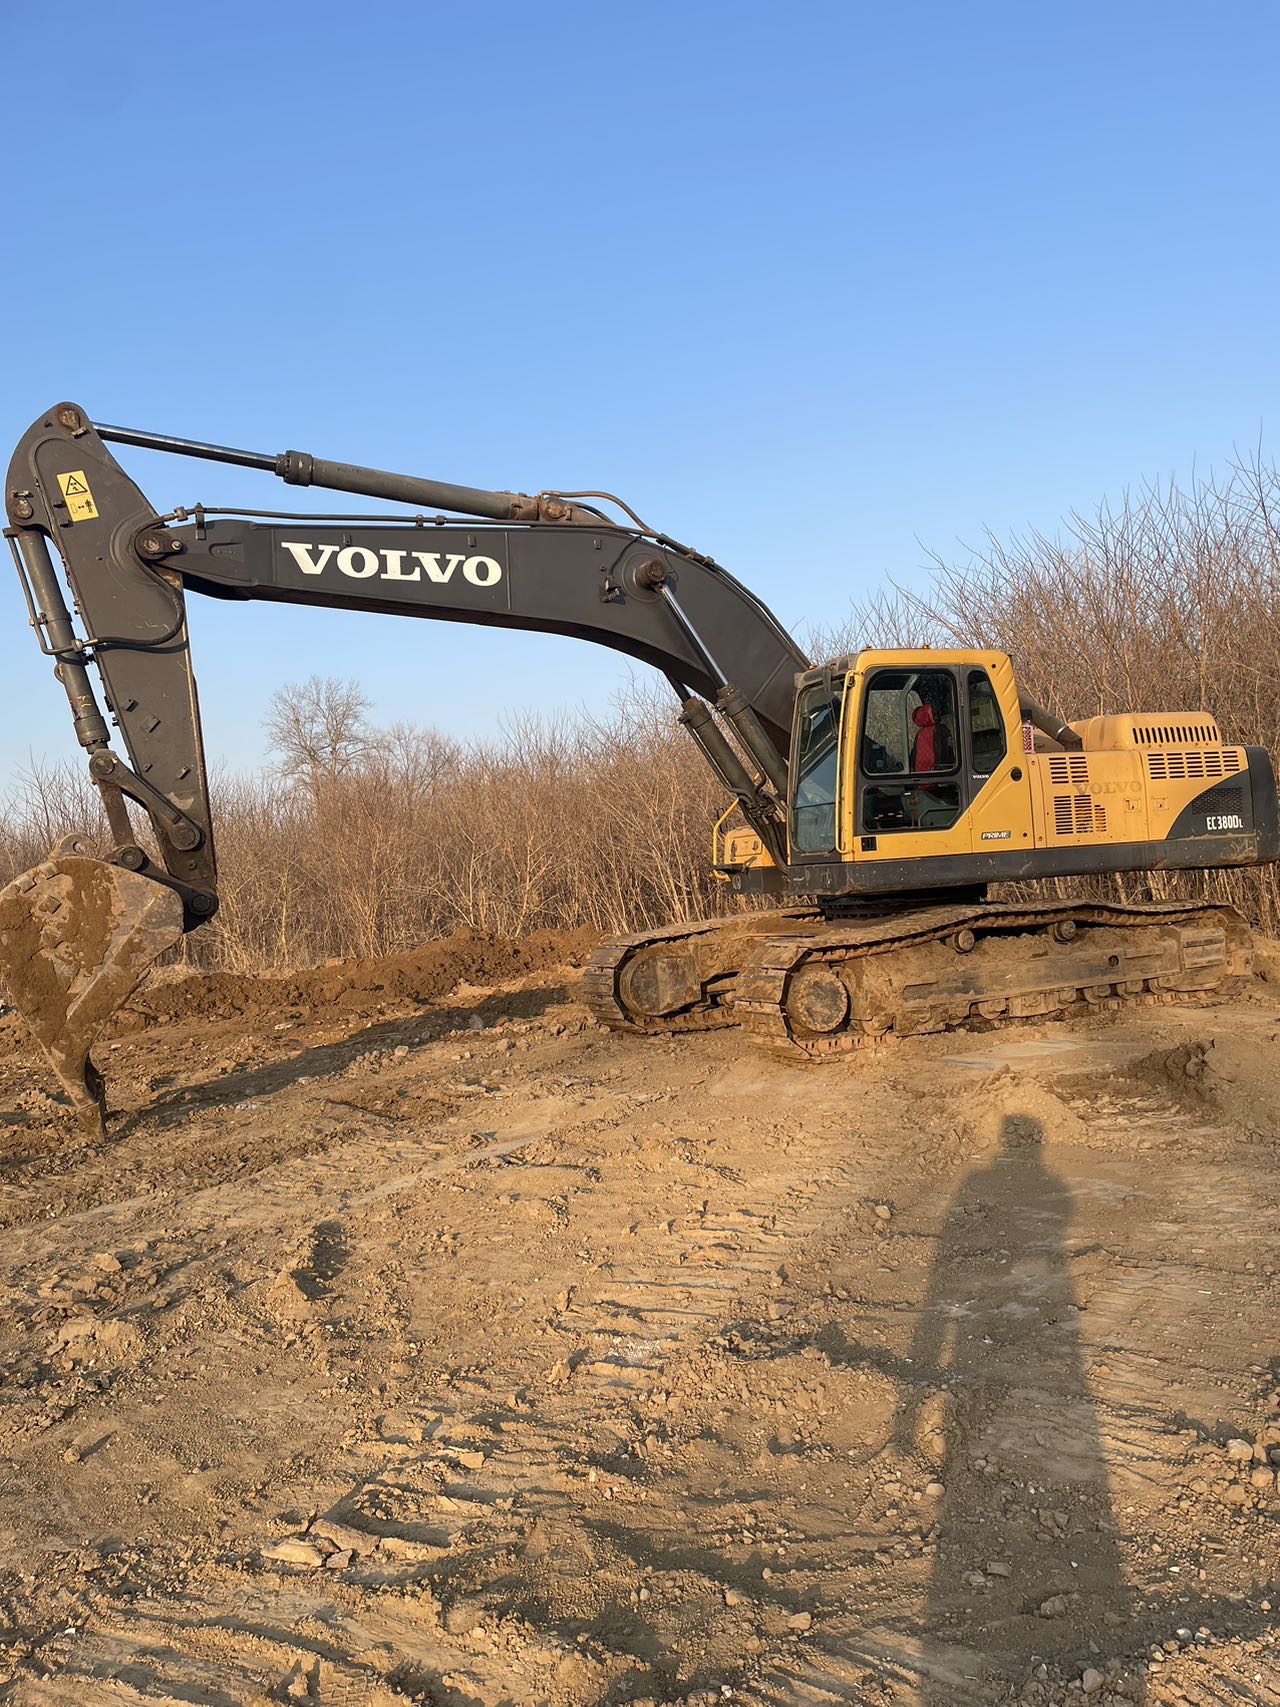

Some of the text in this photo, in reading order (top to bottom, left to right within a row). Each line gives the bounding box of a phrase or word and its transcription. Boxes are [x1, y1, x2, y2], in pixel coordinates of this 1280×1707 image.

[281, 542, 502, 587] VOLVO
[1072, 781, 1142, 795] VOLVO
[1206, 815, 1243, 830] EC380DL
